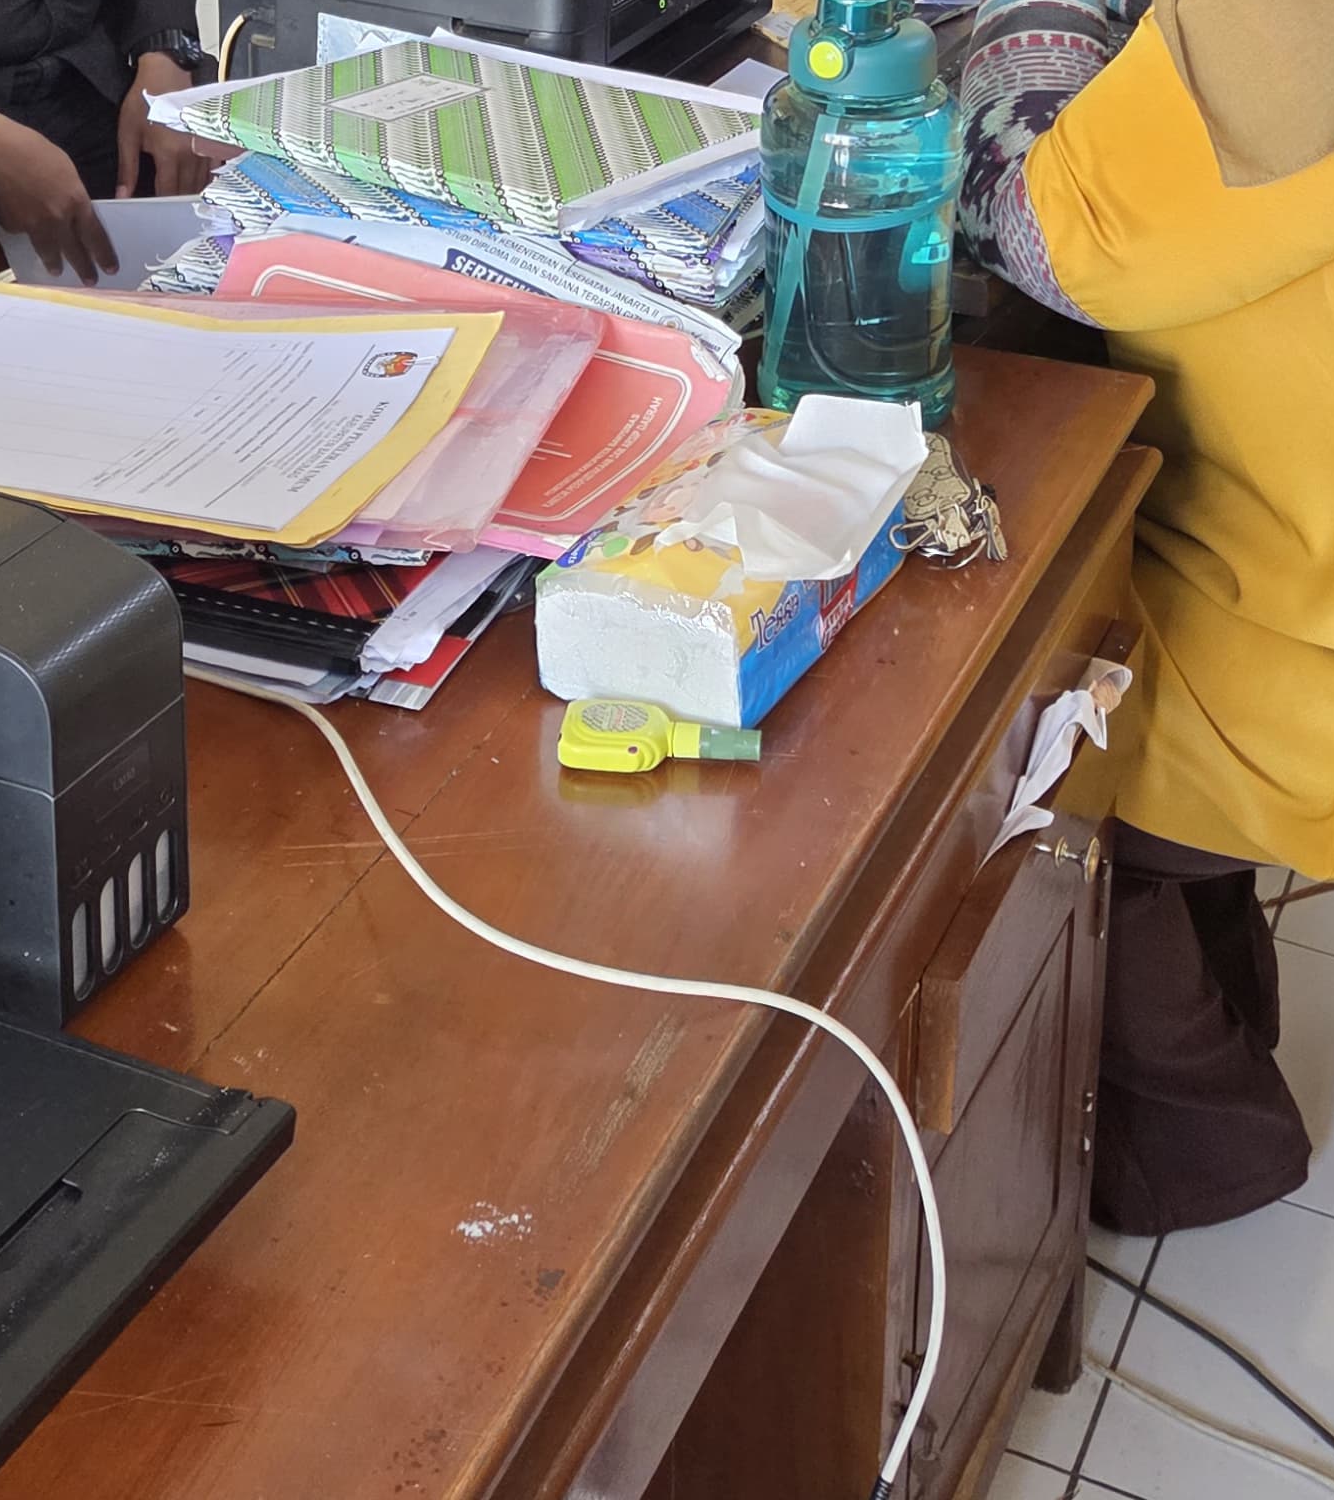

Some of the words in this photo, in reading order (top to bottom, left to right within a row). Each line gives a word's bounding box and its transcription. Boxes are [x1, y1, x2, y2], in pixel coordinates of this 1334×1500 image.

[447, 227, 472, 245] STUDI
[470, 239, 509, 262] DIPLOMA
[519, 260, 542, 275] DAN
[540, 269, 580, 295] SARJANA
[580, 289, 621, 314] TERAPAN
[498, 236, 559, 270] KEMENTERIAN
[610, 289, 650, 314] JAKARTA
[636, 395, 663, 432] DAERAH
[750, 593, 800, 651] Tessa
